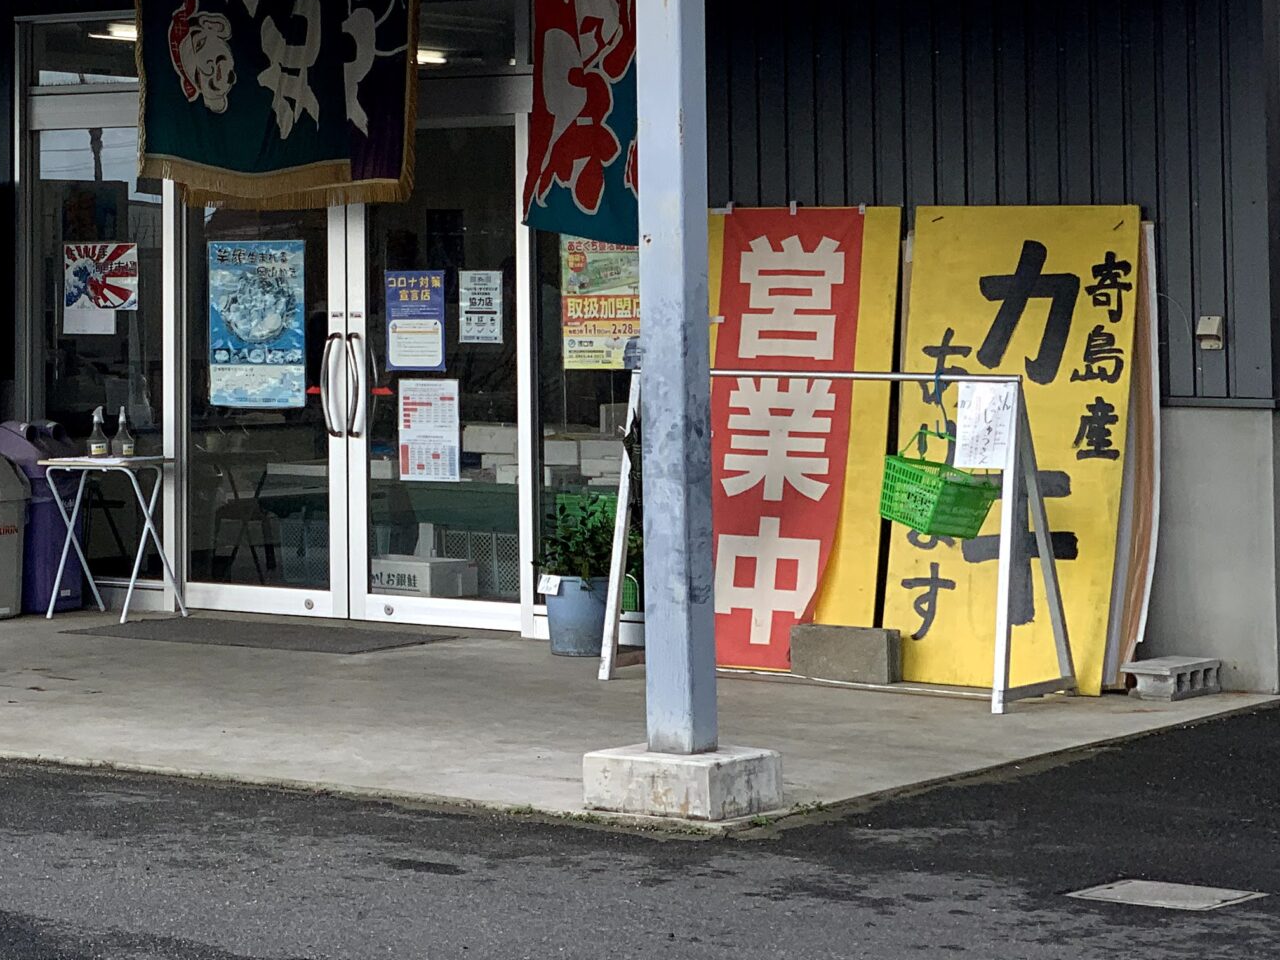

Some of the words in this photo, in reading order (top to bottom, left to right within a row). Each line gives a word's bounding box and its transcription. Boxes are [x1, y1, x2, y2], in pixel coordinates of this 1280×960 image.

[387, 276, 441, 289] コロナ対策
[399, 289, 431, 301] 宣言店
[469, 297, 493, 307] 協力店
[1070, 250, 1134, 461] 寄島産
[714, 234, 846, 647] 営業中
[901, 328, 972, 642] ありす
